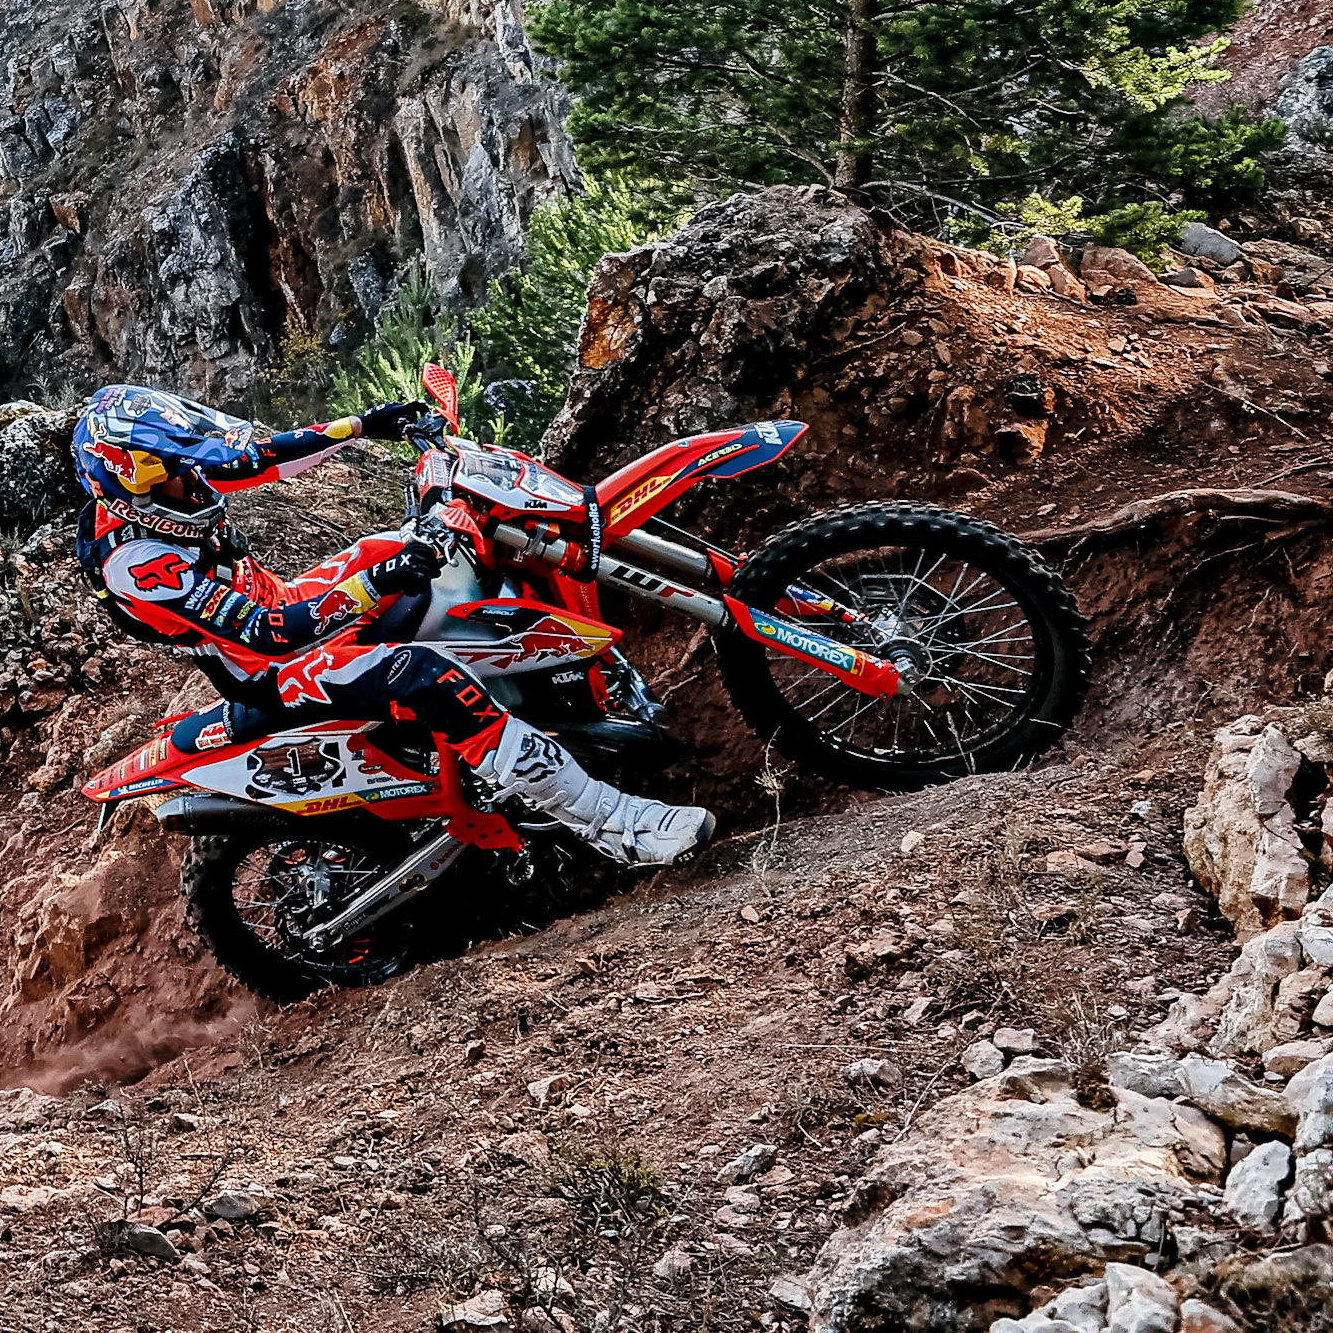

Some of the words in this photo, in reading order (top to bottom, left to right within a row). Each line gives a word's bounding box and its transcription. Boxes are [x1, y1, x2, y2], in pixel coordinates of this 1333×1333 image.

[524, 500, 548, 509] KTM
[616, 478, 664, 515] DHL
[109, 498, 161, 529] Red
[372, 553, 412, 578] FOX
[608, 565, 698, 599] WP
[775, 627, 851, 669] MOTOREX
[551, 671, 584, 685] KTM
[436, 668, 501, 722] FOX
[286, 747, 302, 777] 1
[128, 778, 164, 791] MICHELIN
[379, 784, 429, 800] MOTOREX
[304, 795, 353, 814] DHL
